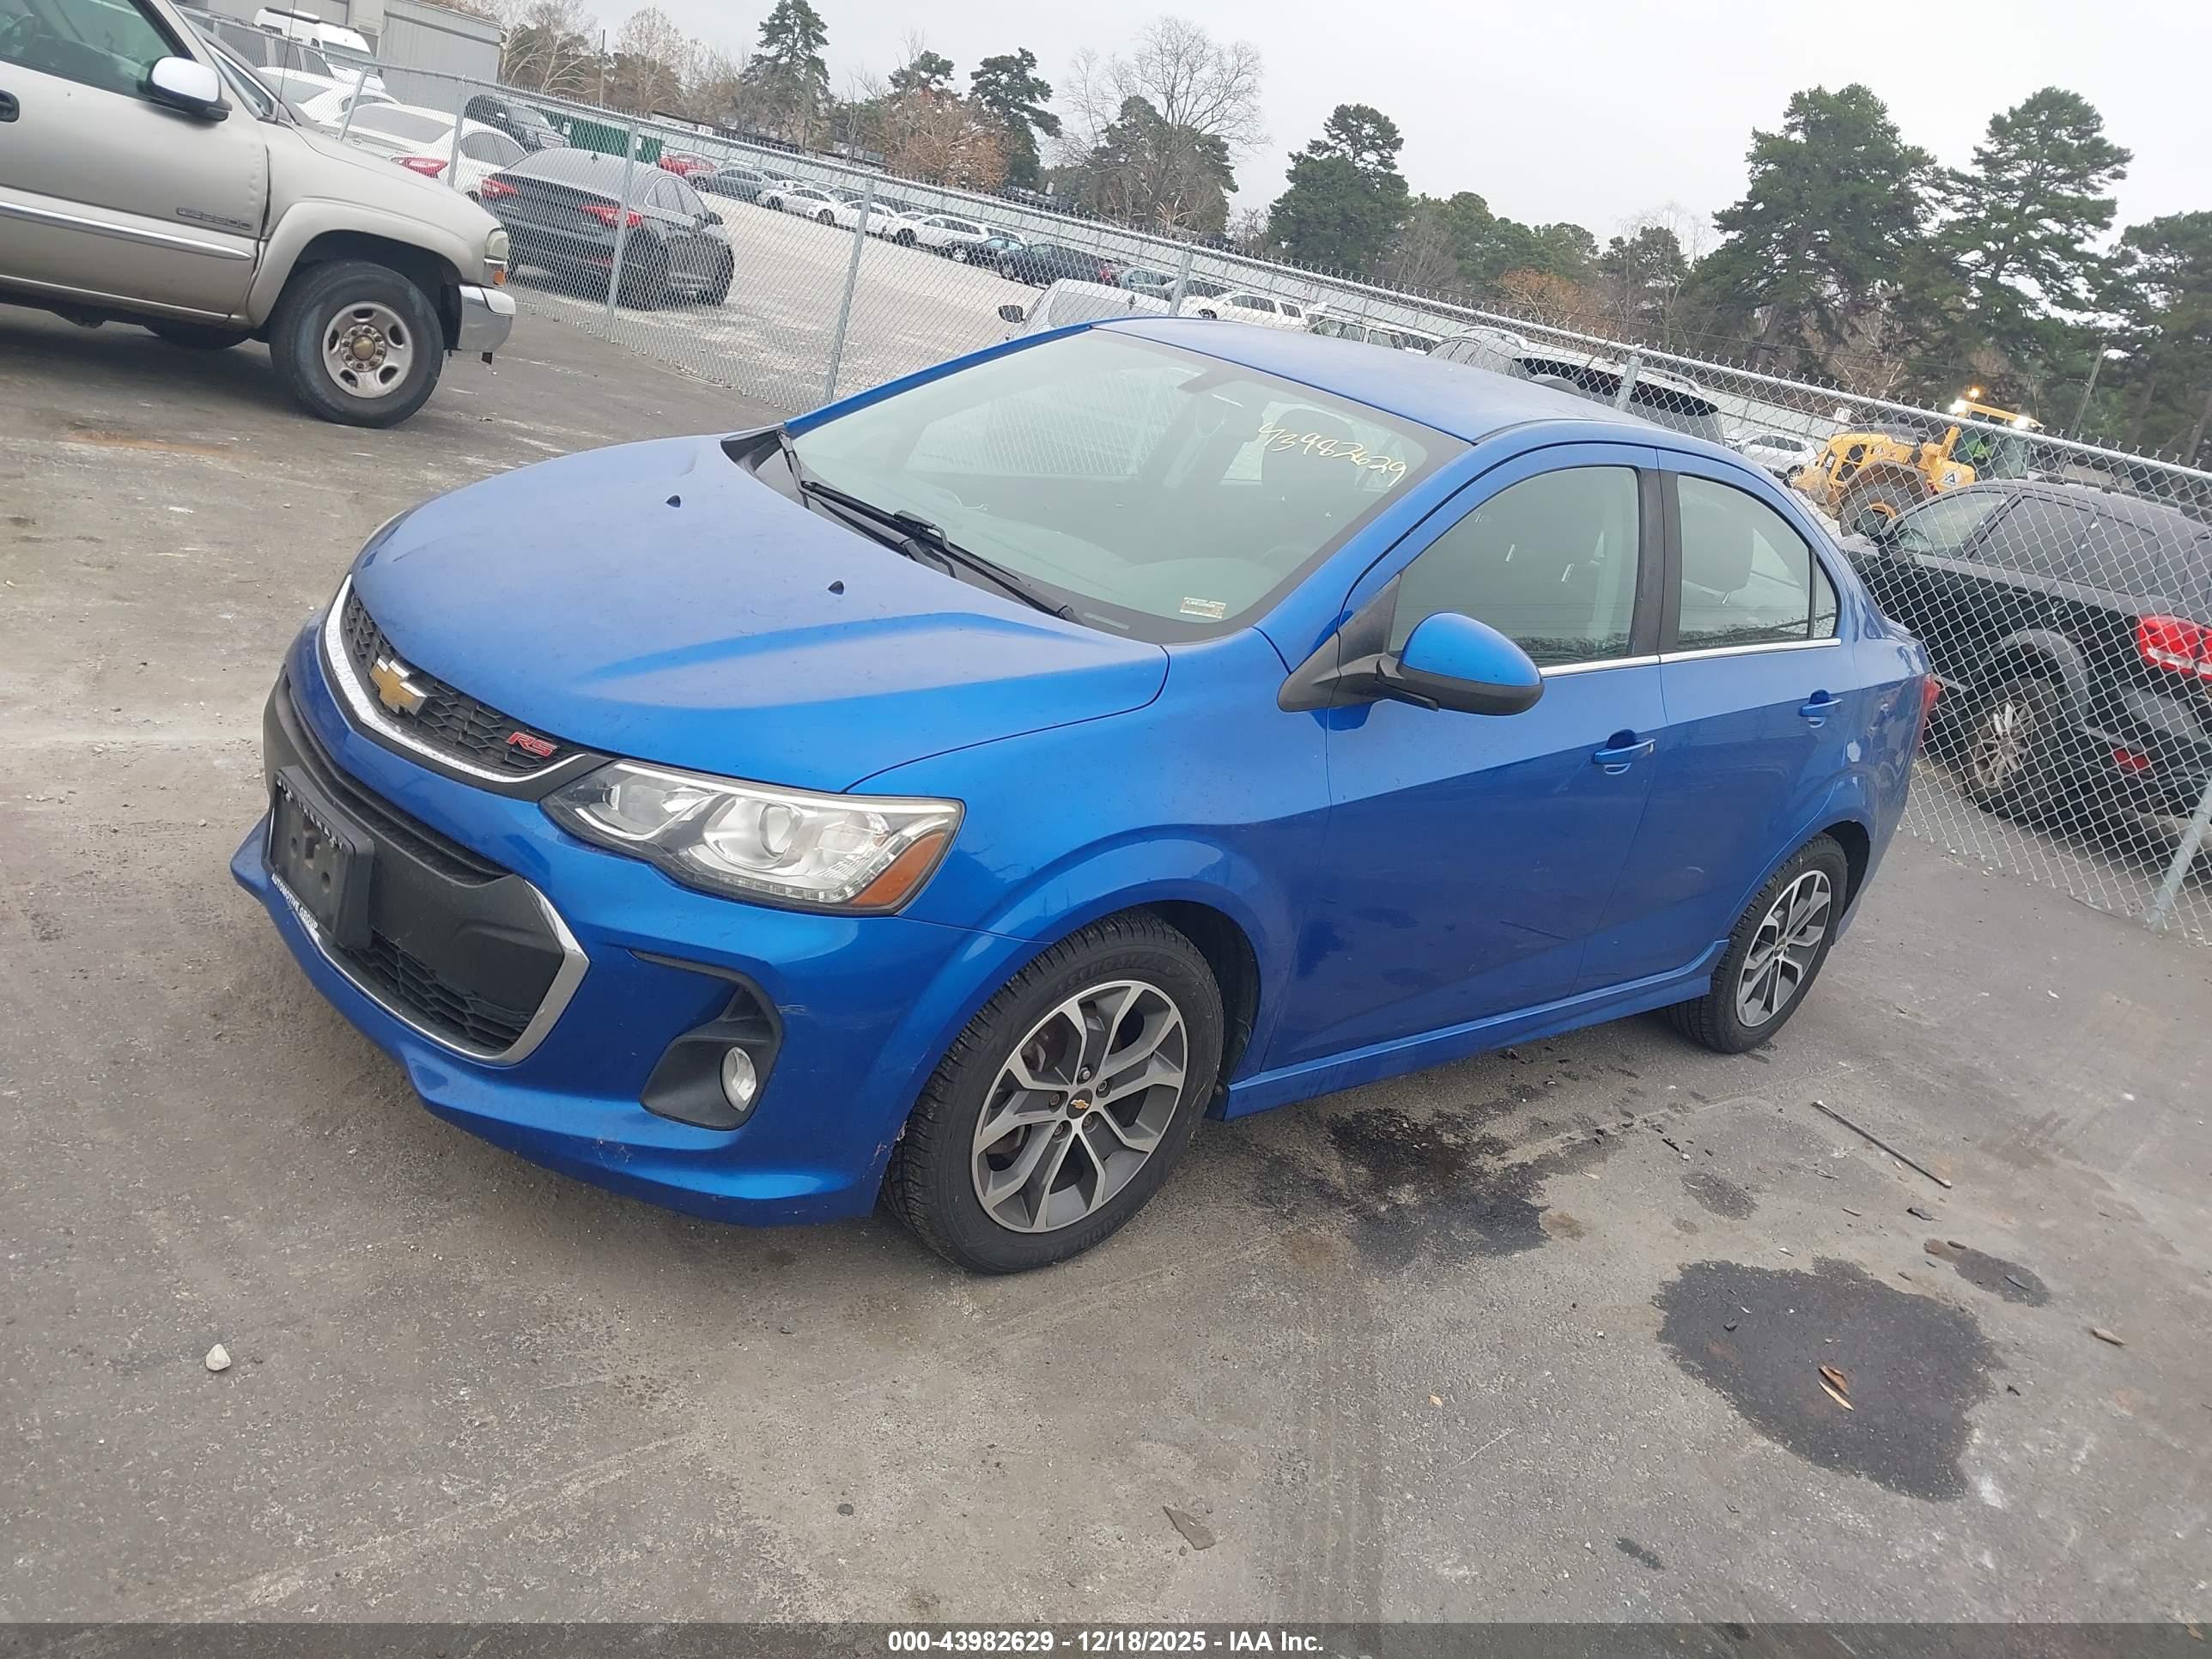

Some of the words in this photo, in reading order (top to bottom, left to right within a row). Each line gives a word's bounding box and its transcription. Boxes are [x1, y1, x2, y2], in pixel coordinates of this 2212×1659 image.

[507, 732, 557, 757] RS
[270, 872, 300, 911] AUTOMOTIVE
[299, 906, 319, 930] GROUP
